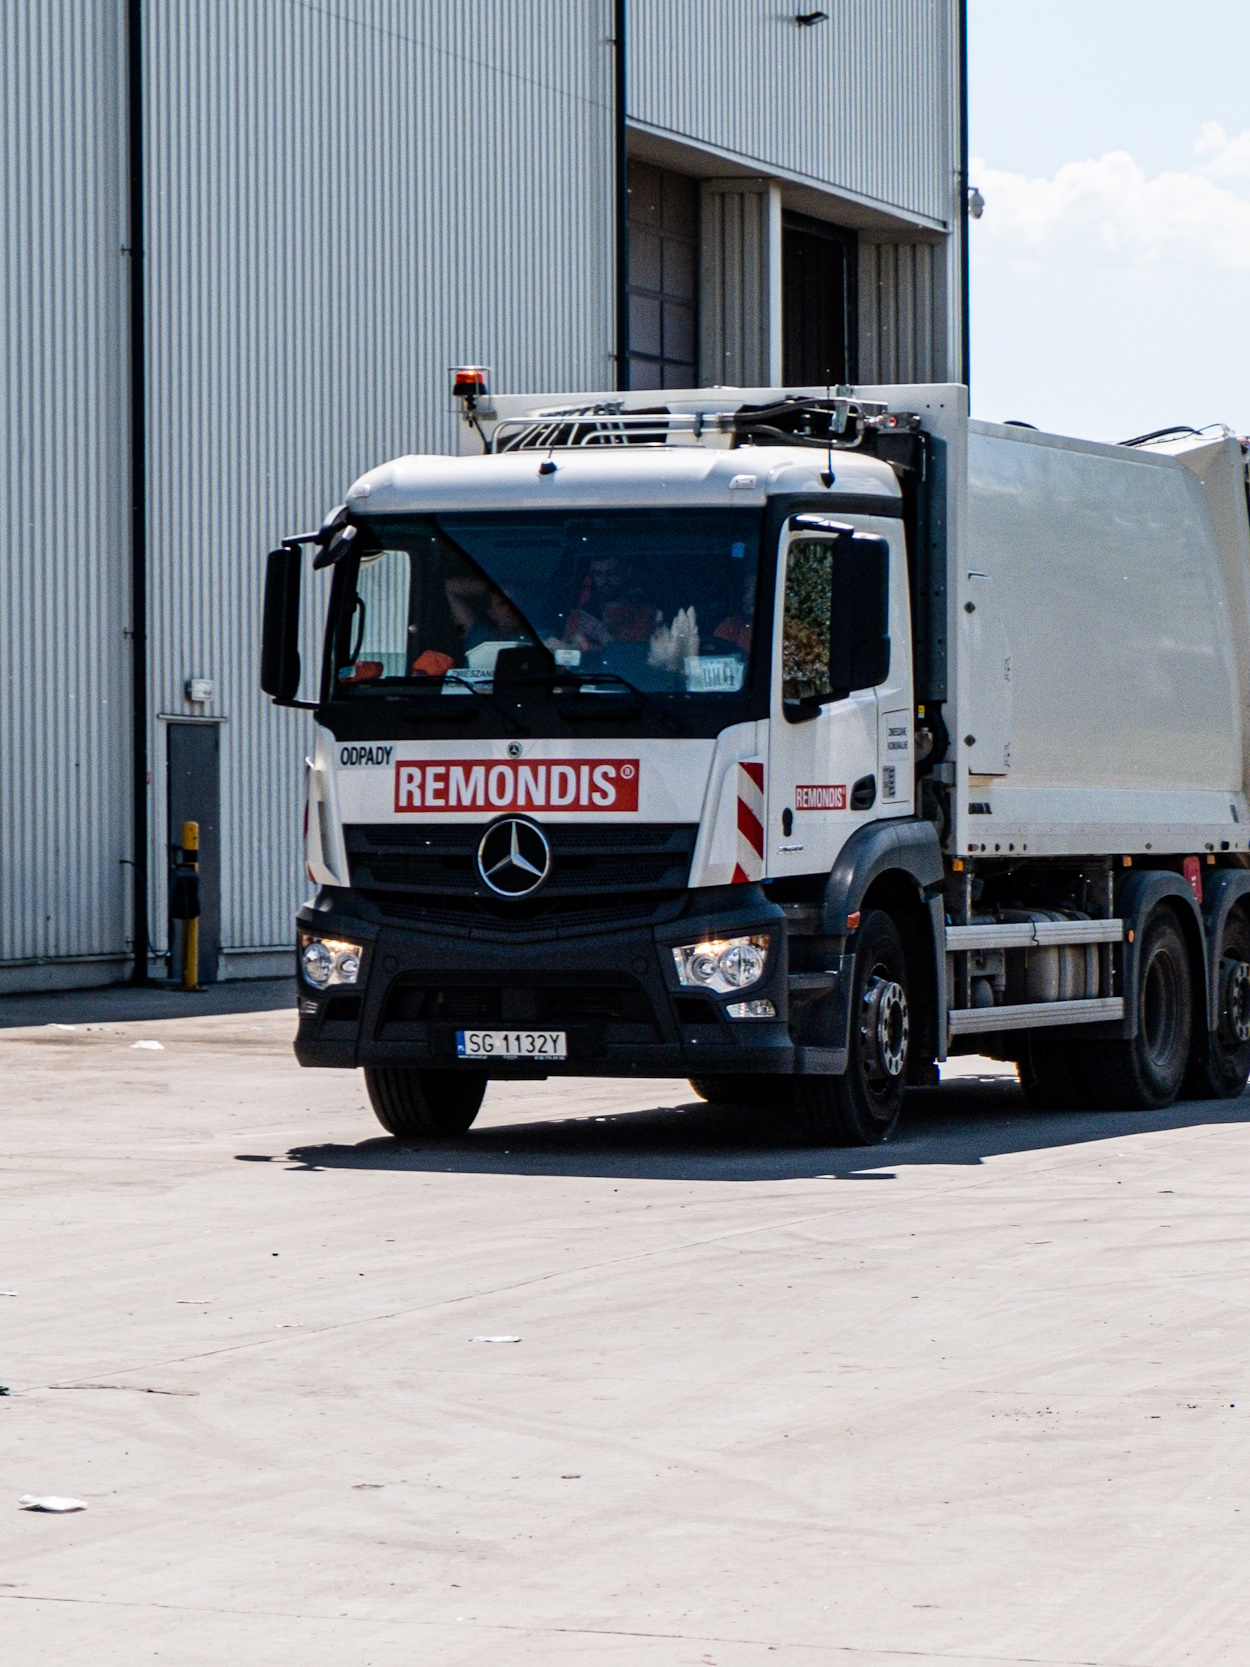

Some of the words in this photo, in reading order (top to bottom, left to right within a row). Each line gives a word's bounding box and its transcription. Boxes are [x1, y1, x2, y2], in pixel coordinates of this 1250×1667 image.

[340, 746, 393, 766] ODPADY
[469, 1033, 494, 1053] SG
[502, 1034, 560, 1053] 1132Y
